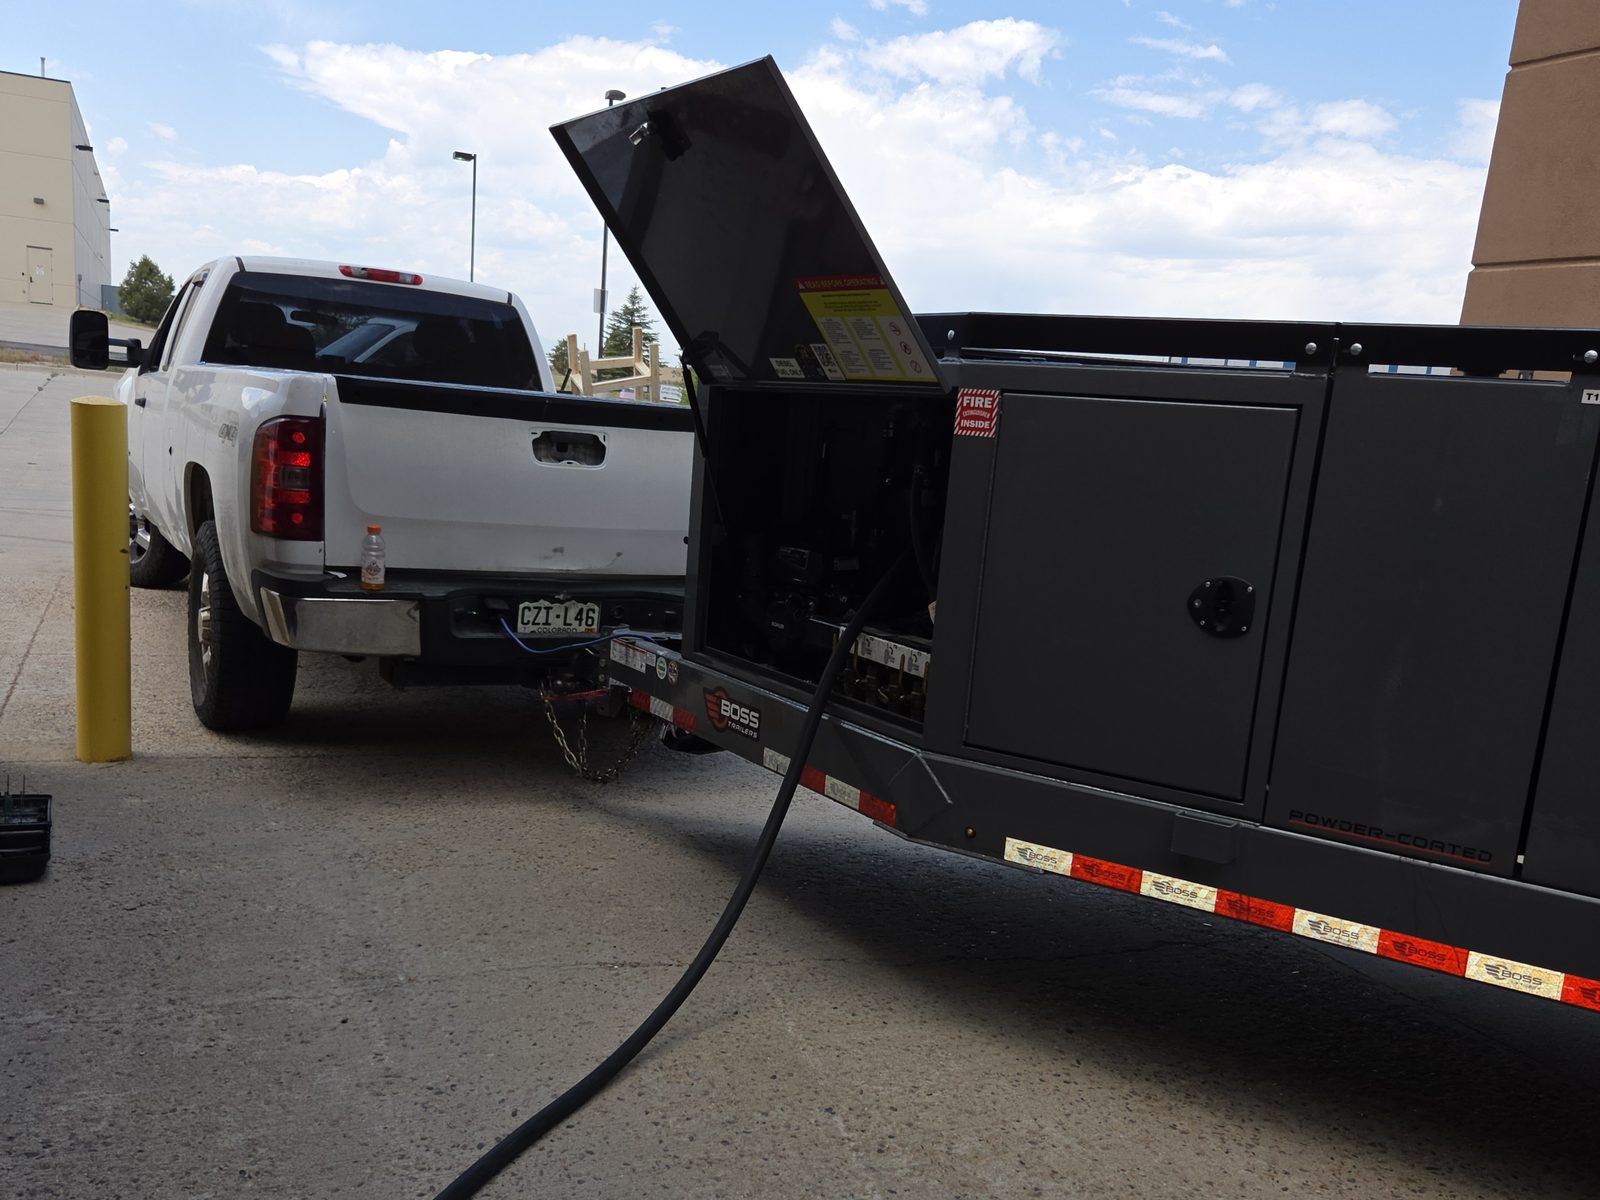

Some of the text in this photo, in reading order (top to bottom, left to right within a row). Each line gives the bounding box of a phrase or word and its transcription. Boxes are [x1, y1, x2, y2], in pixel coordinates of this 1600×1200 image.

[962, 396, 993, 408] FIRE
[960, 419, 990, 429] INSIDE
[720, 699, 760, 729] BOSS
[727, 720, 758, 739] TRAILERS
[1289, 810, 1492, 862] POWDER-COATED
[1028, 851, 1058, 865] BOSS
[1165, 886, 1198, 899] BOSS
[1323, 925, 1360, 940] BOSS
[1408, 946, 1448, 961] BOSS
[1501, 969, 1542, 986] BOSS
